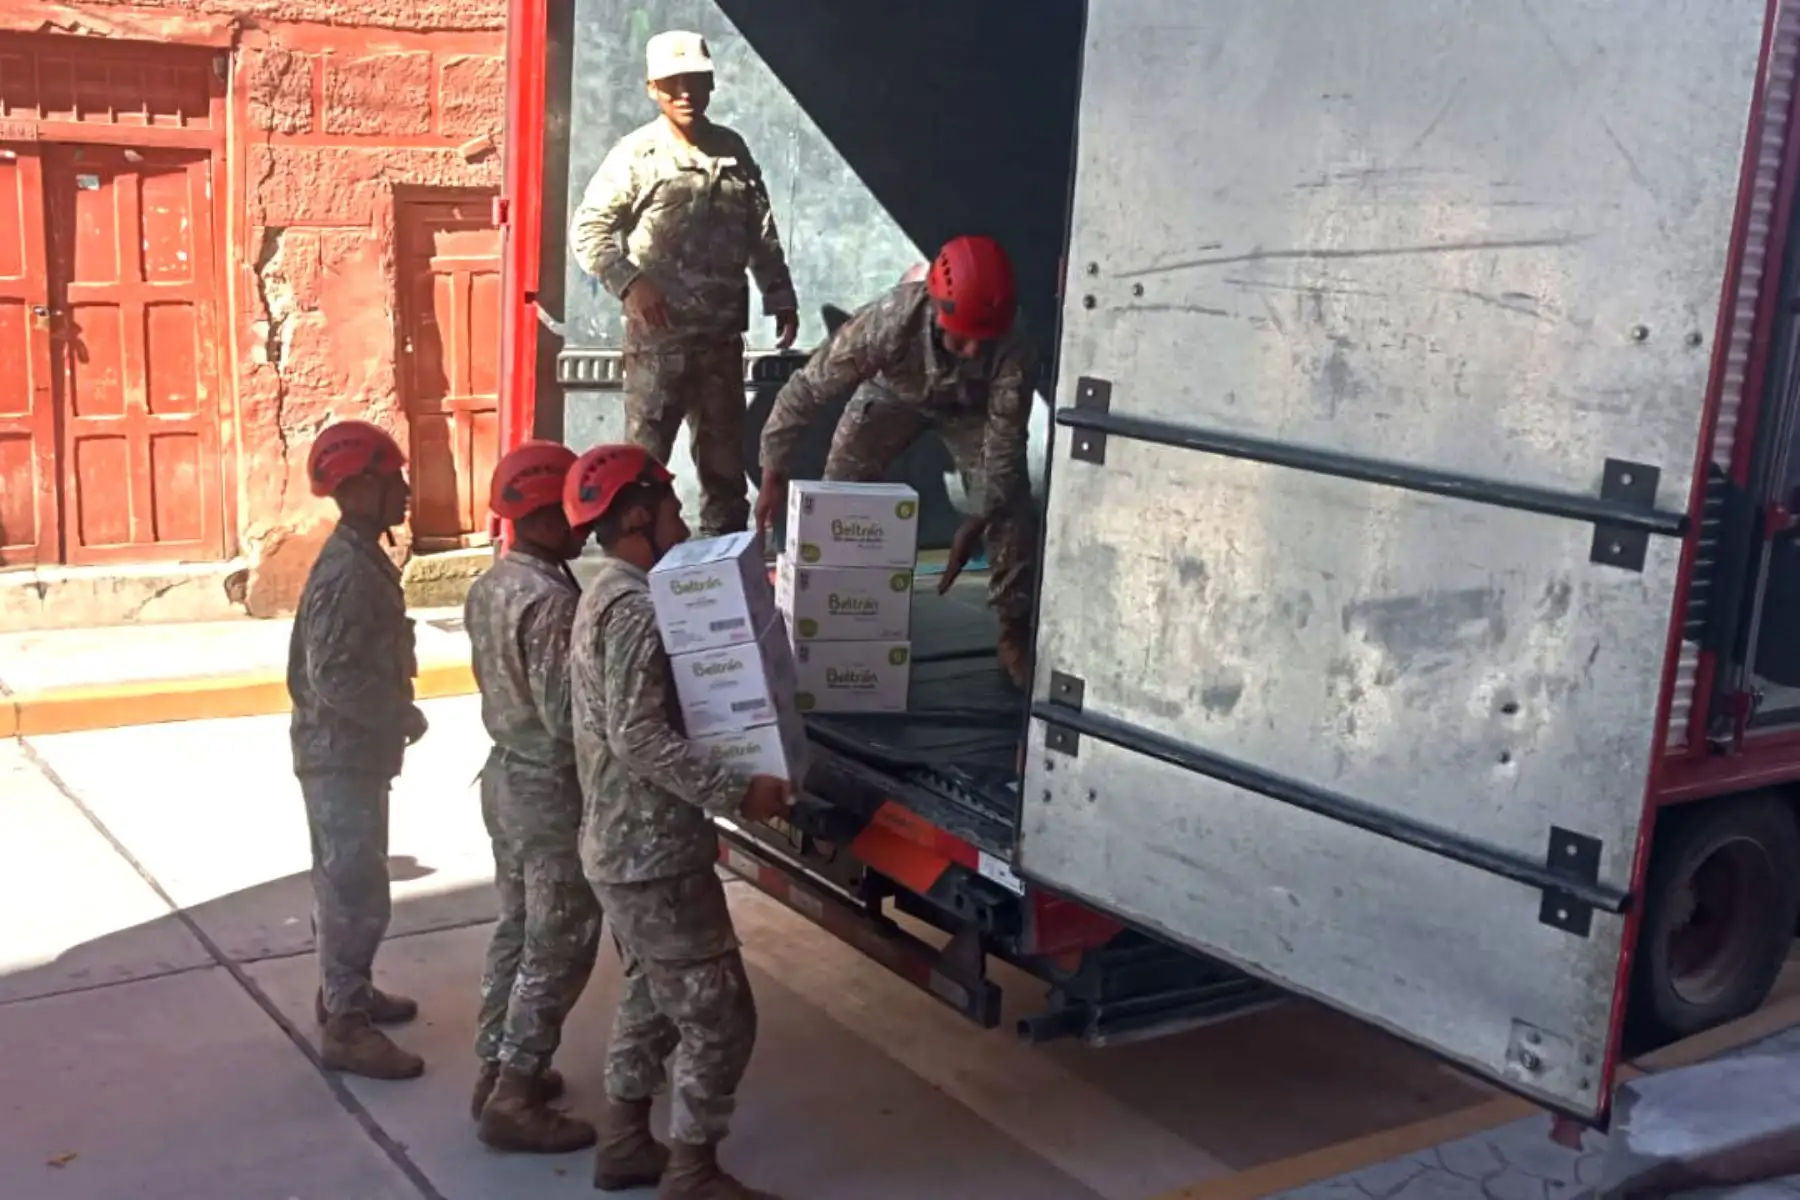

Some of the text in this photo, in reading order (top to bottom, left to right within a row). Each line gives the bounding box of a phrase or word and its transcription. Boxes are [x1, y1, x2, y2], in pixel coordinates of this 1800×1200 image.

[831, 519, 884, 536] Beltrán
[669, 576, 723, 595] Beltrán
[828, 593, 879, 610] Beltrán
[692, 659, 743, 677] Beltrán
